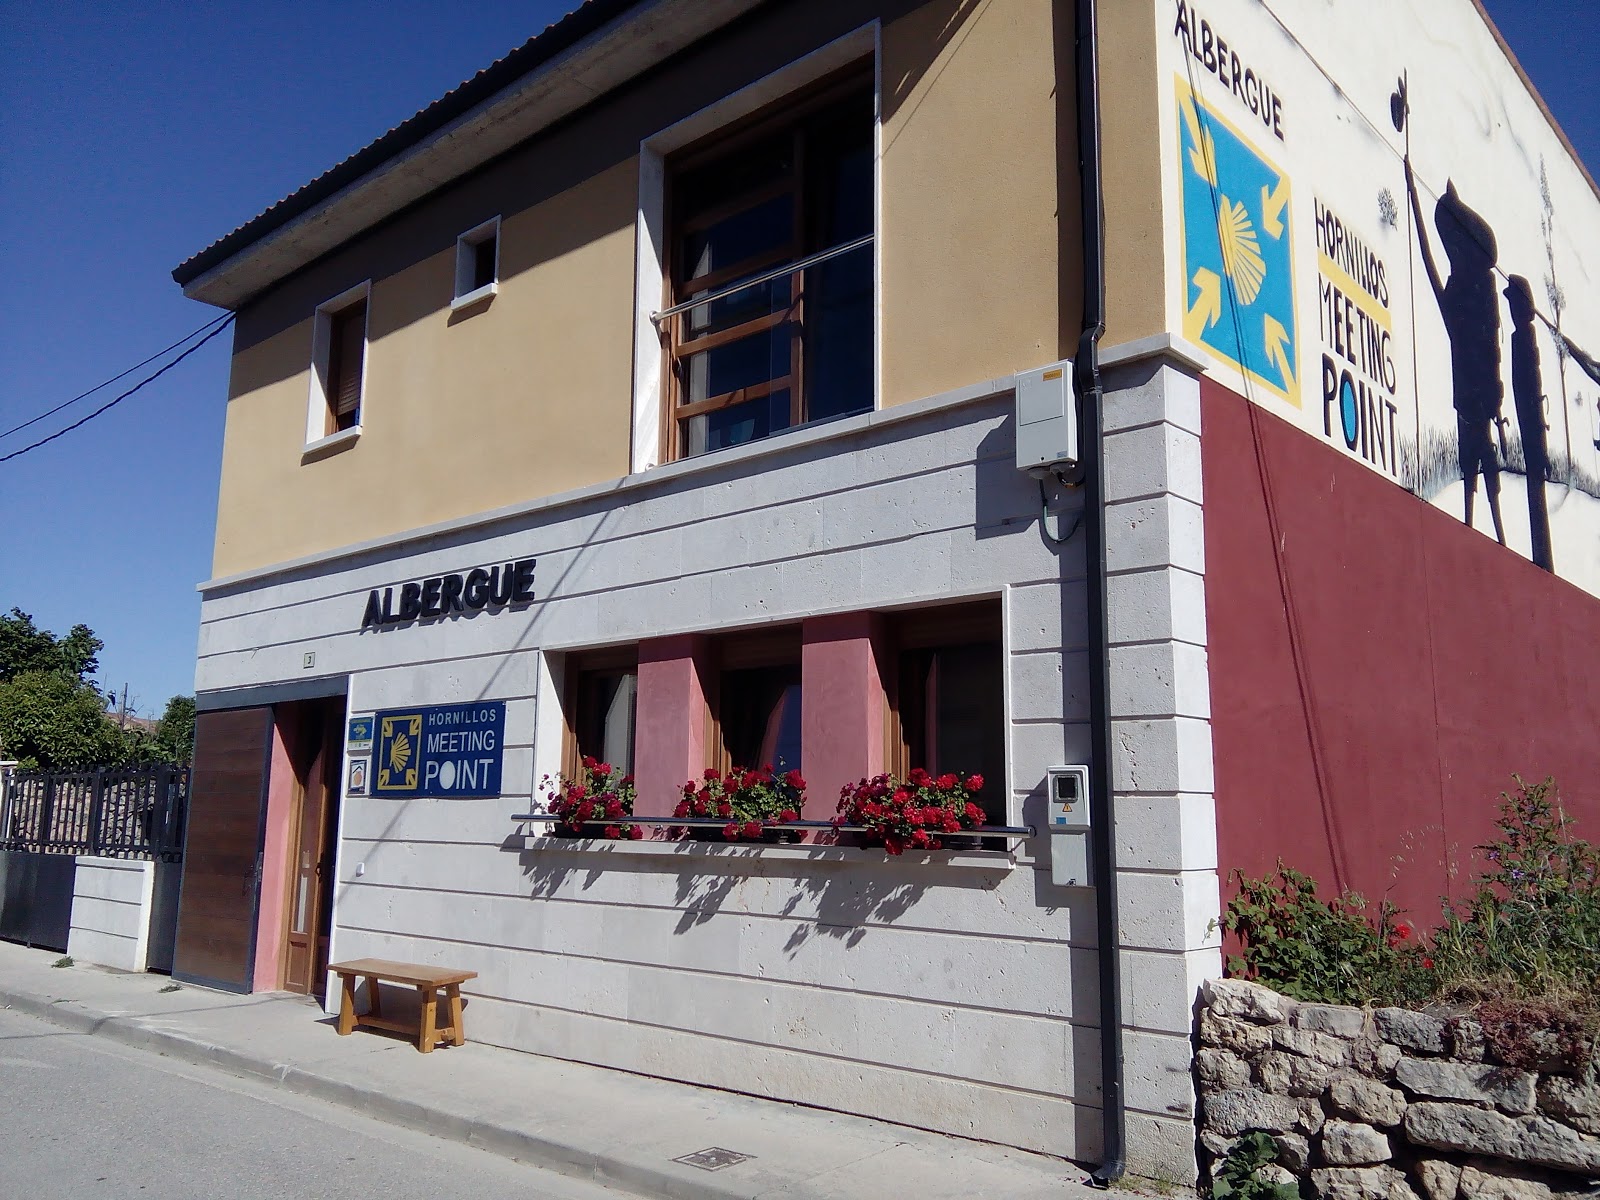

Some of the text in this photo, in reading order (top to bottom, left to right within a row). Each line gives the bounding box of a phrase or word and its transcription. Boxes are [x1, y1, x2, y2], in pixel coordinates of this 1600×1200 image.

[1174, 0, 1285, 142] ALBERGUE
[1314, 196, 1389, 308] HORNILLOS
[1318, 272, 1397, 396] MEETING
[1322, 352, 1398, 477] POINT
[361, 559, 537, 628] ALBERGUE
[427, 729, 496, 753] MEETING
[428, 708, 497, 726] HORNILLOS
[424, 758, 494, 790] POINT
